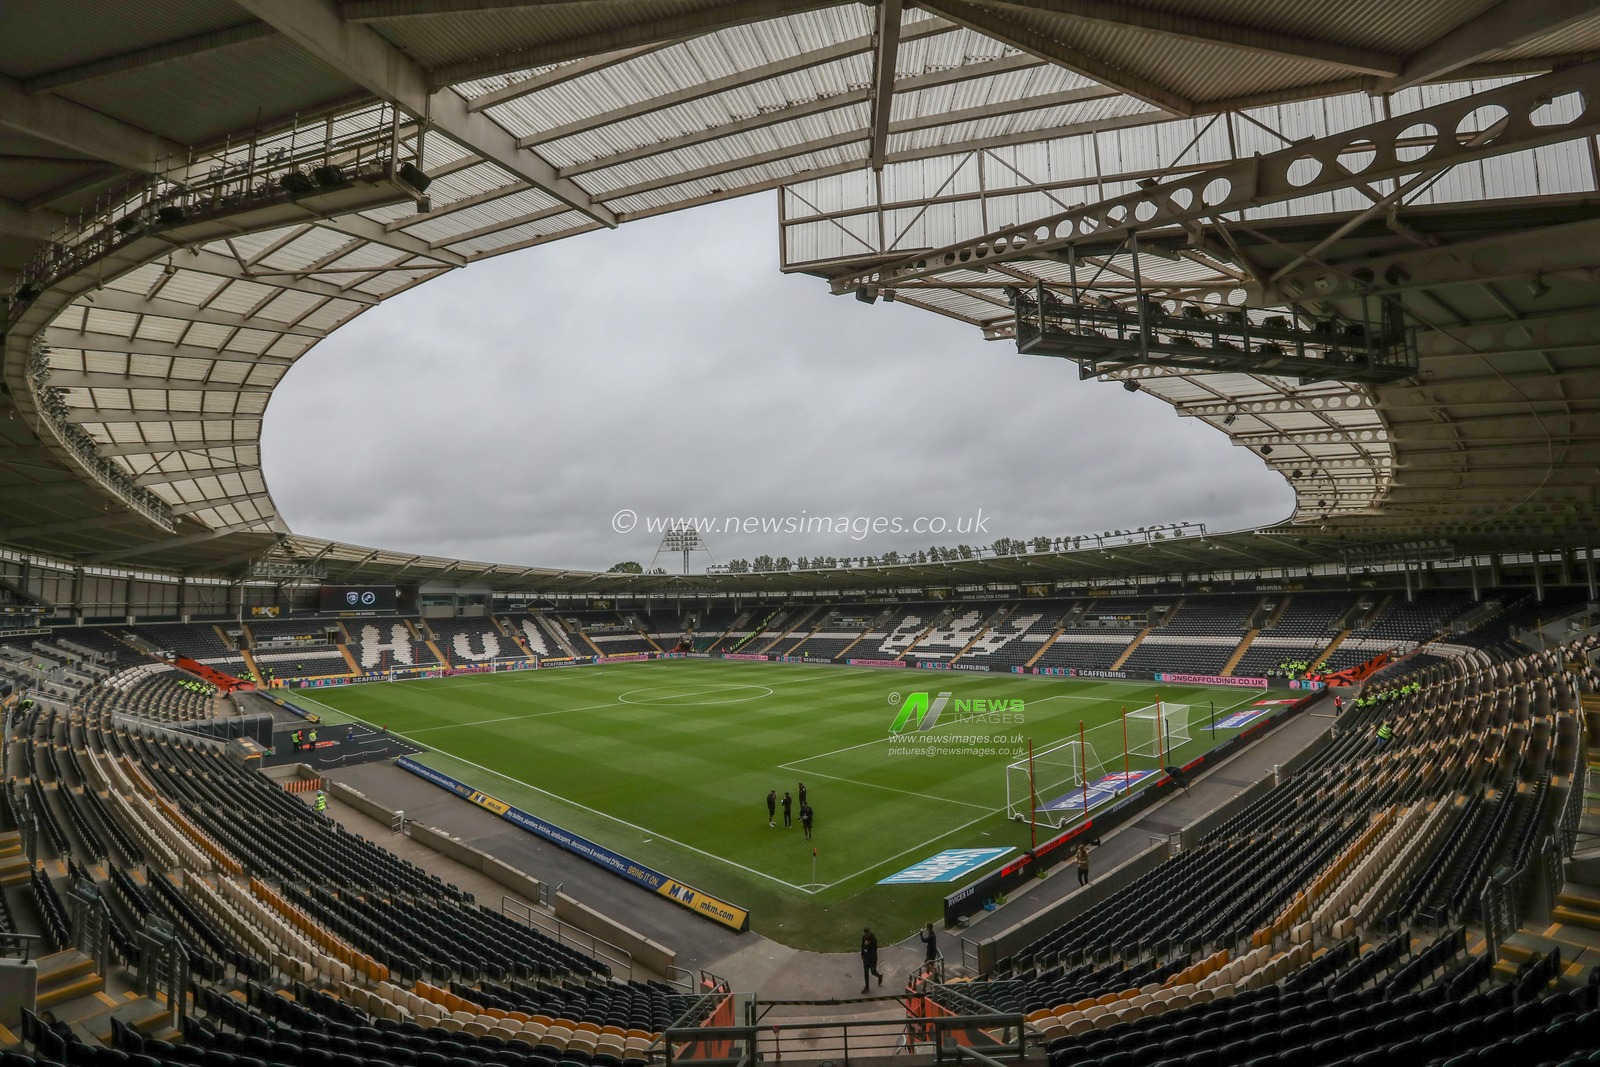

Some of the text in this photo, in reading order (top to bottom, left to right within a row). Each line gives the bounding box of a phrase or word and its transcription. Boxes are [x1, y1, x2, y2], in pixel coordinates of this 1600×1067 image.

[252, 606, 279, 617] MKM
[1041, 668, 1126, 678] TILSON SCAFFOLDING
[627, 866, 643, 880] BRING
[643, 872, 649, 882] IT
[669, 883, 695, 904] MKM
[700, 901, 733, 921] mkm.com
